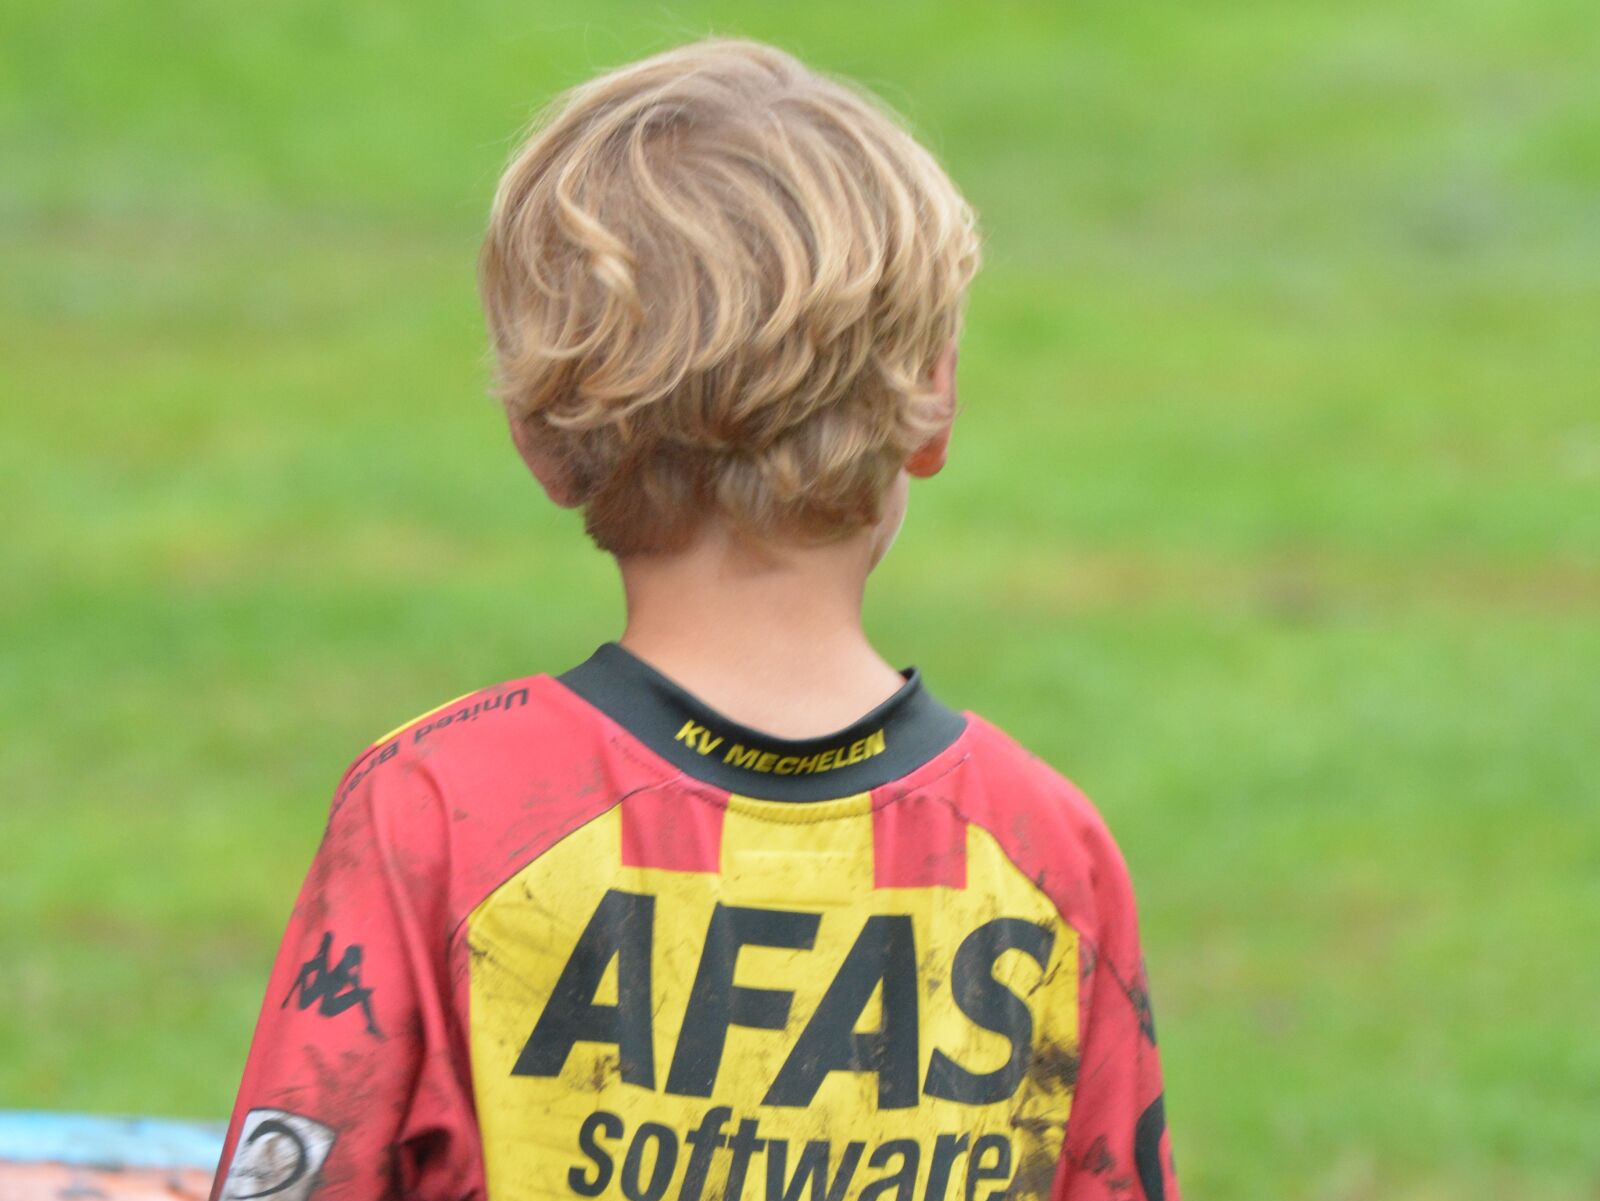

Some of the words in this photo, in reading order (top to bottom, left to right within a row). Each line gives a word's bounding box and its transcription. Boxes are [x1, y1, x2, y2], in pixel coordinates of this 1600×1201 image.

[413, 687, 529, 744] United
[674, 719, 724, 756] KV
[722, 728, 887, 775] MECHELEN
[510, 888, 1056, 1109] AFAS
